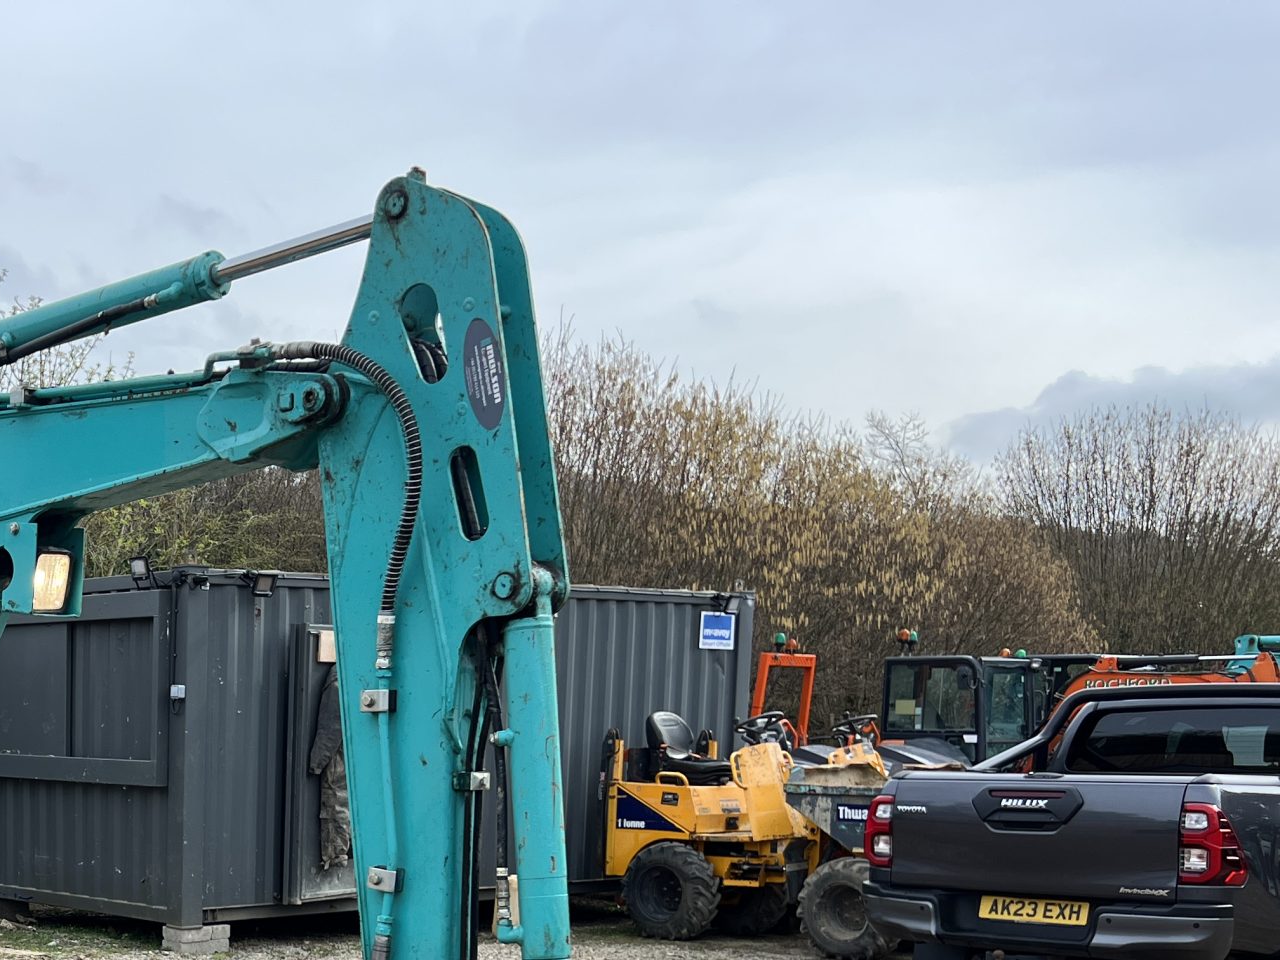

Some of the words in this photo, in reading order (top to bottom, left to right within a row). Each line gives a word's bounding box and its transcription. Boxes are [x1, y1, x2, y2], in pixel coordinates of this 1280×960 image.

[1000, 798, 1049, 809] HILUX
[896, 805, 927, 814] TOYOTA
[988, 897, 1038, 918] AK23
[1042, 901, 1082, 921] EXH
